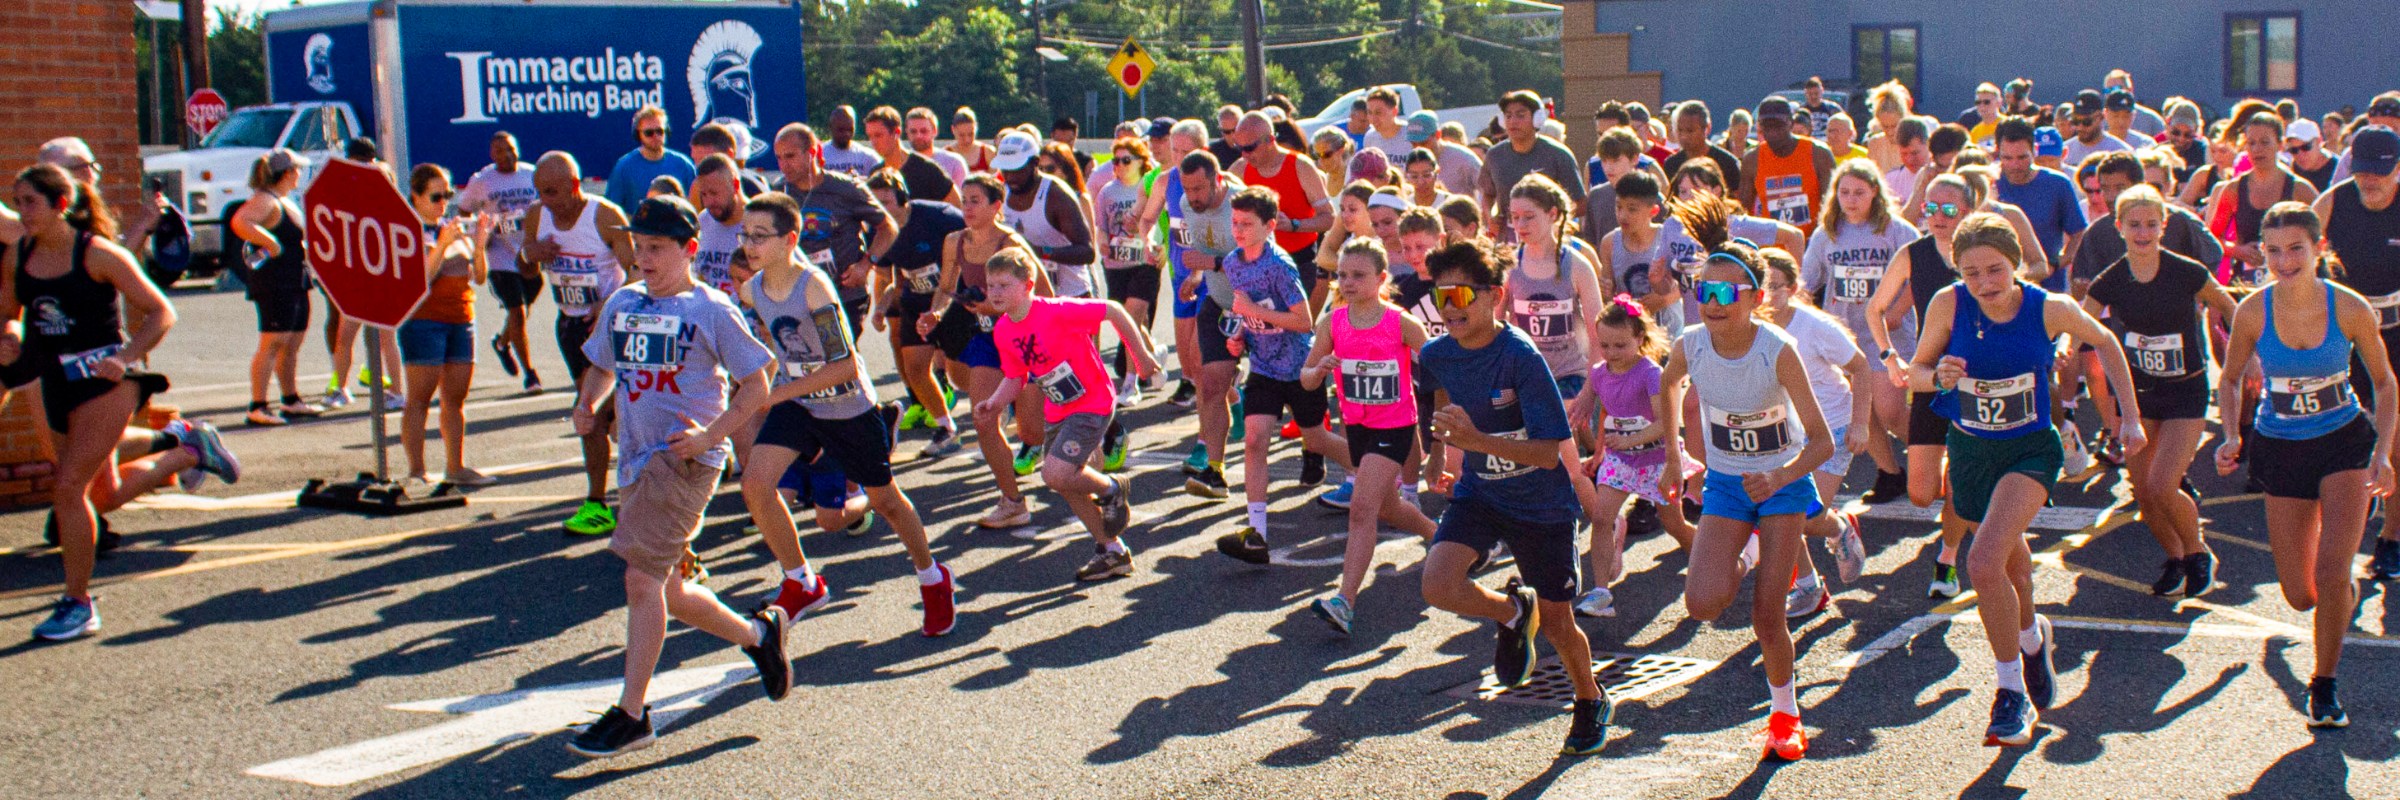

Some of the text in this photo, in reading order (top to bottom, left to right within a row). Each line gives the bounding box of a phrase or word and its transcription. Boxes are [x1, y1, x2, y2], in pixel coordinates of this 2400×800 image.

[445, 47, 663, 124] Immaculata
[487, 84, 663, 116] Marching Band
[190, 103, 226, 122] STOP
[313, 203, 416, 279] STOP
[1114, 247, 1131, 261] 123
[1828, 248, 1890, 264] SPARTAN
[560, 286, 585, 304] 106
[1842, 279, 1869, 297] 199
[1225, 318, 1242, 334] 17
[1529, 316, 1551, 336] 67
[623, 333, 649, 362] 48
[2135, 350, 2166, 371] 168
[635, 365, 685, 394] 5K
[1353, 376, 1384, 398] 114
[1977, 397, 2006, 423] 52
[2291, 392, 2321, 414] 45
[1729, 428, 1759, 451] 50
